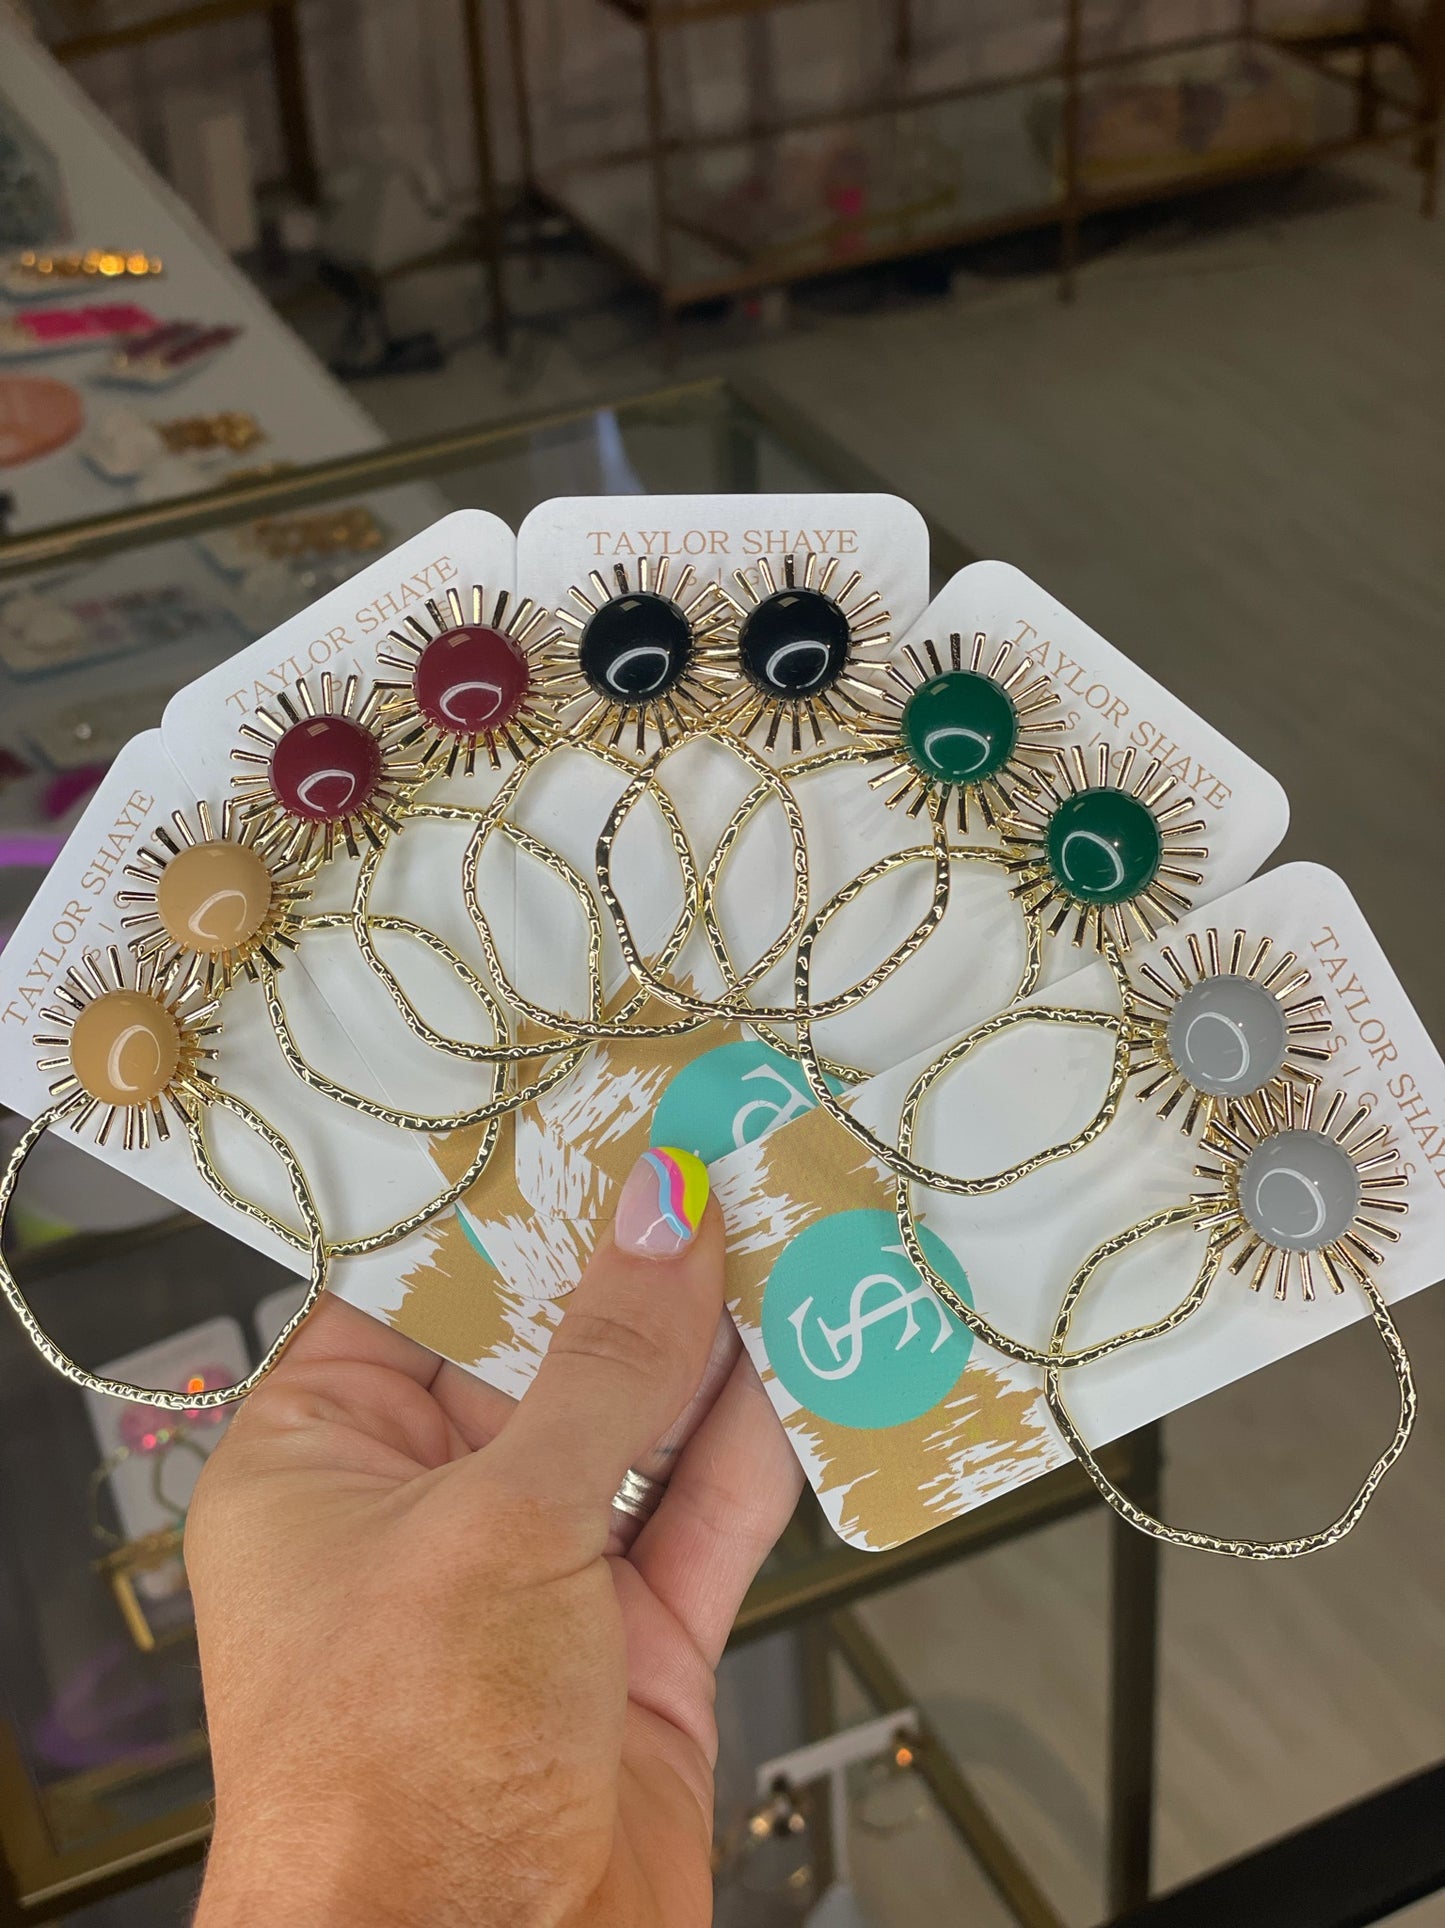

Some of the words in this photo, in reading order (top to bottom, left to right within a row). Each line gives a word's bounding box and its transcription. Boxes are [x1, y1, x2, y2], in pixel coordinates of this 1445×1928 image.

[587, 529, 730, 556] TAYLOR
[743, 528, 860, 555] SHAYE
[225, 626, 355, 716] TAYLOR
[355, 555, 459, 634] SHAYE
[1010, 619, 1130, 729] TAYLOR
[1129, 720, 1233, 810] SHAYE
[1, 899, 93, 1026] TAYLOR
[80, 789, 156, 896] SHAYE
[1310, 926, 1399, 1071] TAYLOR
